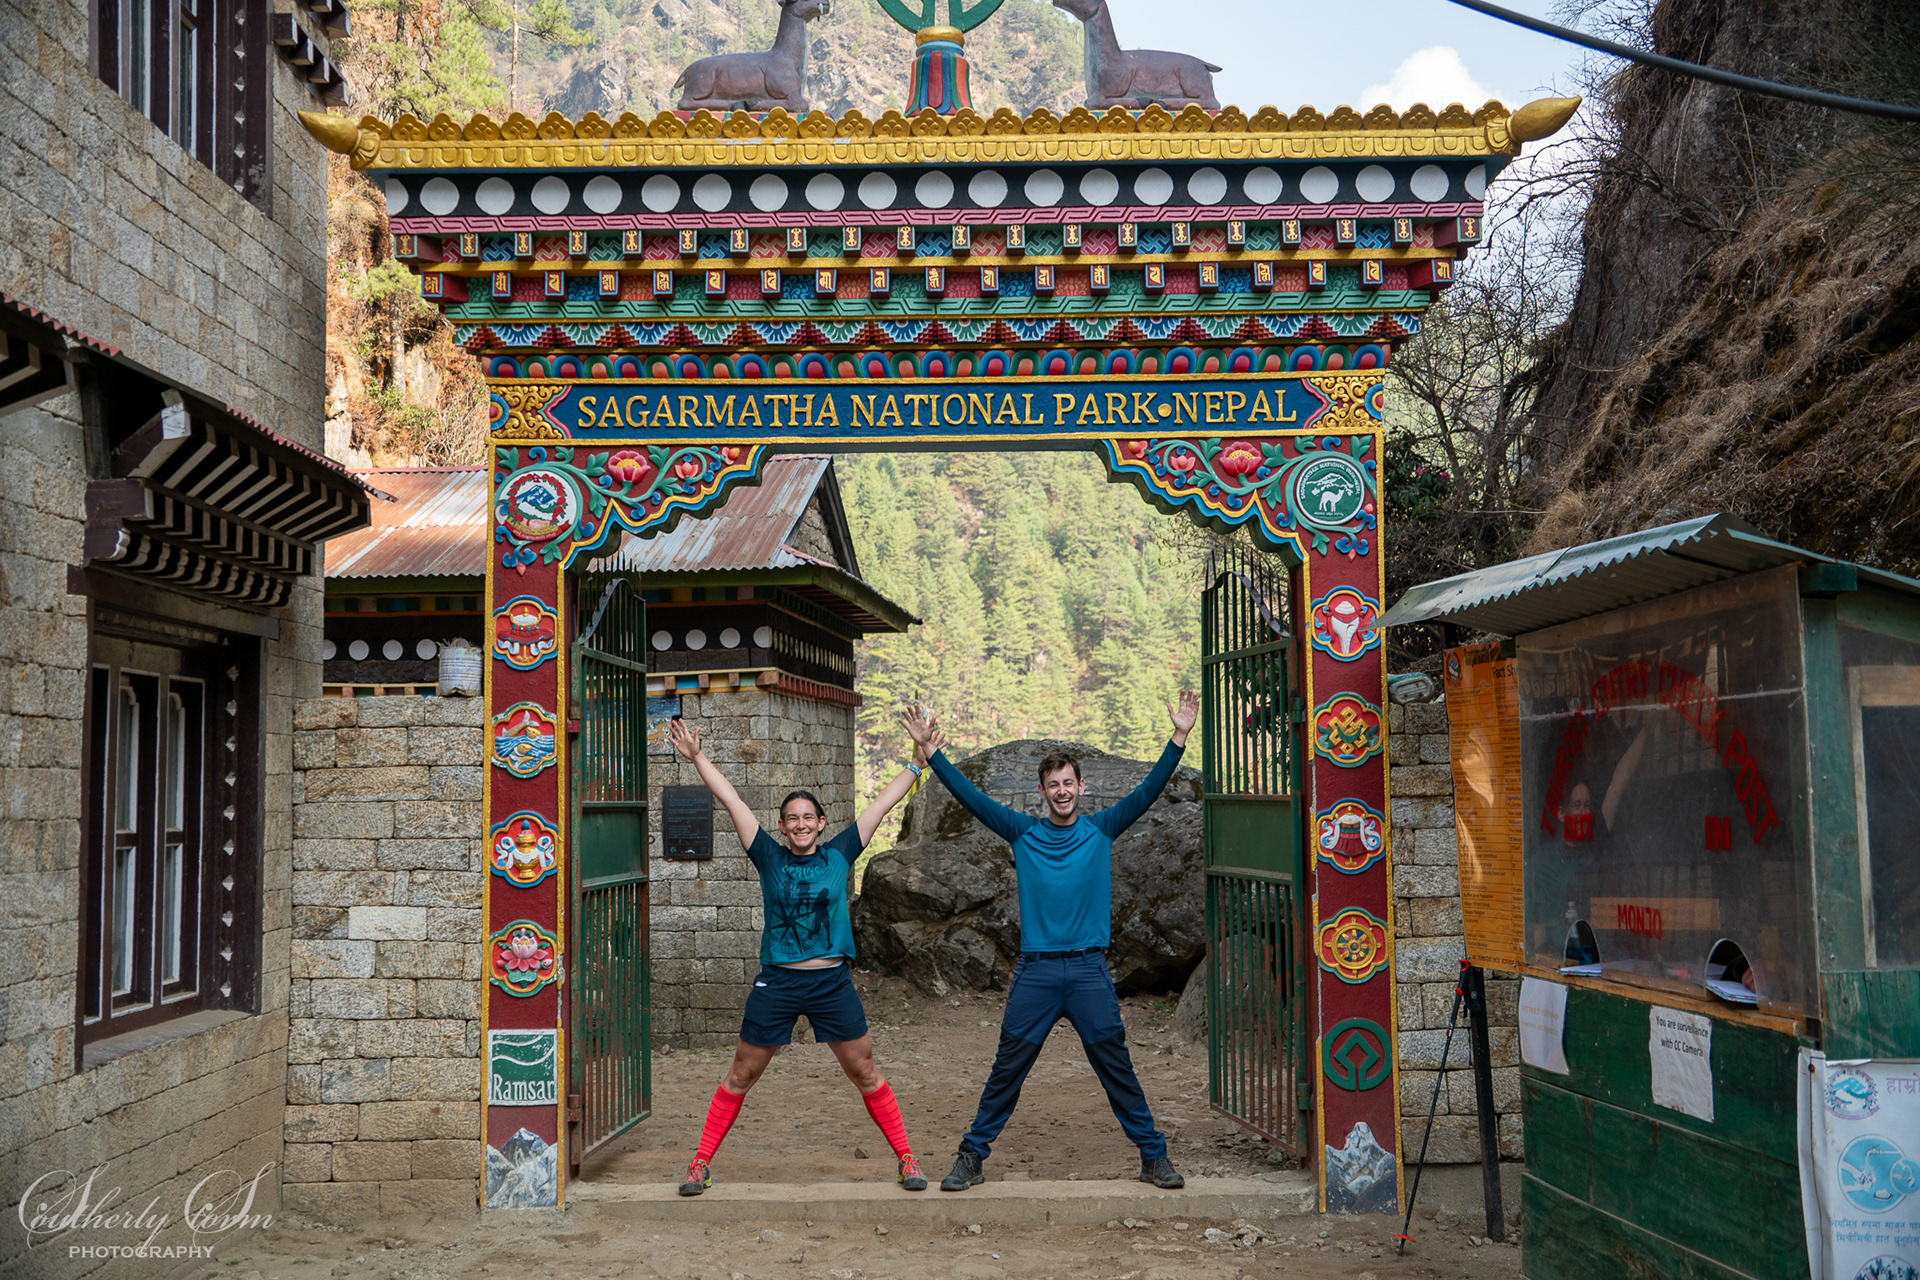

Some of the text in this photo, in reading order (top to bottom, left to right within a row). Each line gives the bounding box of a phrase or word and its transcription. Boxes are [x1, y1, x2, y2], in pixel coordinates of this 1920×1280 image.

[576, 394, 841, 428] SAGARMATHA
[850, 393, 1044, 427] NATIONAL
[1300, 466, 1319, 500] SAGARMATHA
[1319, 462, 1345, 470] NATIONAL
[1492, 664, 1517, 679] Fact Sh
[1540, 660, 1779, 845] TOURIST ENTRY CHECK POST
[1564, 813, 1594, 842] OUT
[1705, 816, 1732, 850] IN
[1617, 903, 1664, 940] MONJO
[1655, 1015, 1666, 1027] You
[1667, 1020, 1676, 1029] are
[1661, 1037, 1703, 1057] with CC Camera
[492, 1073, 555, 1101] Ramsar
